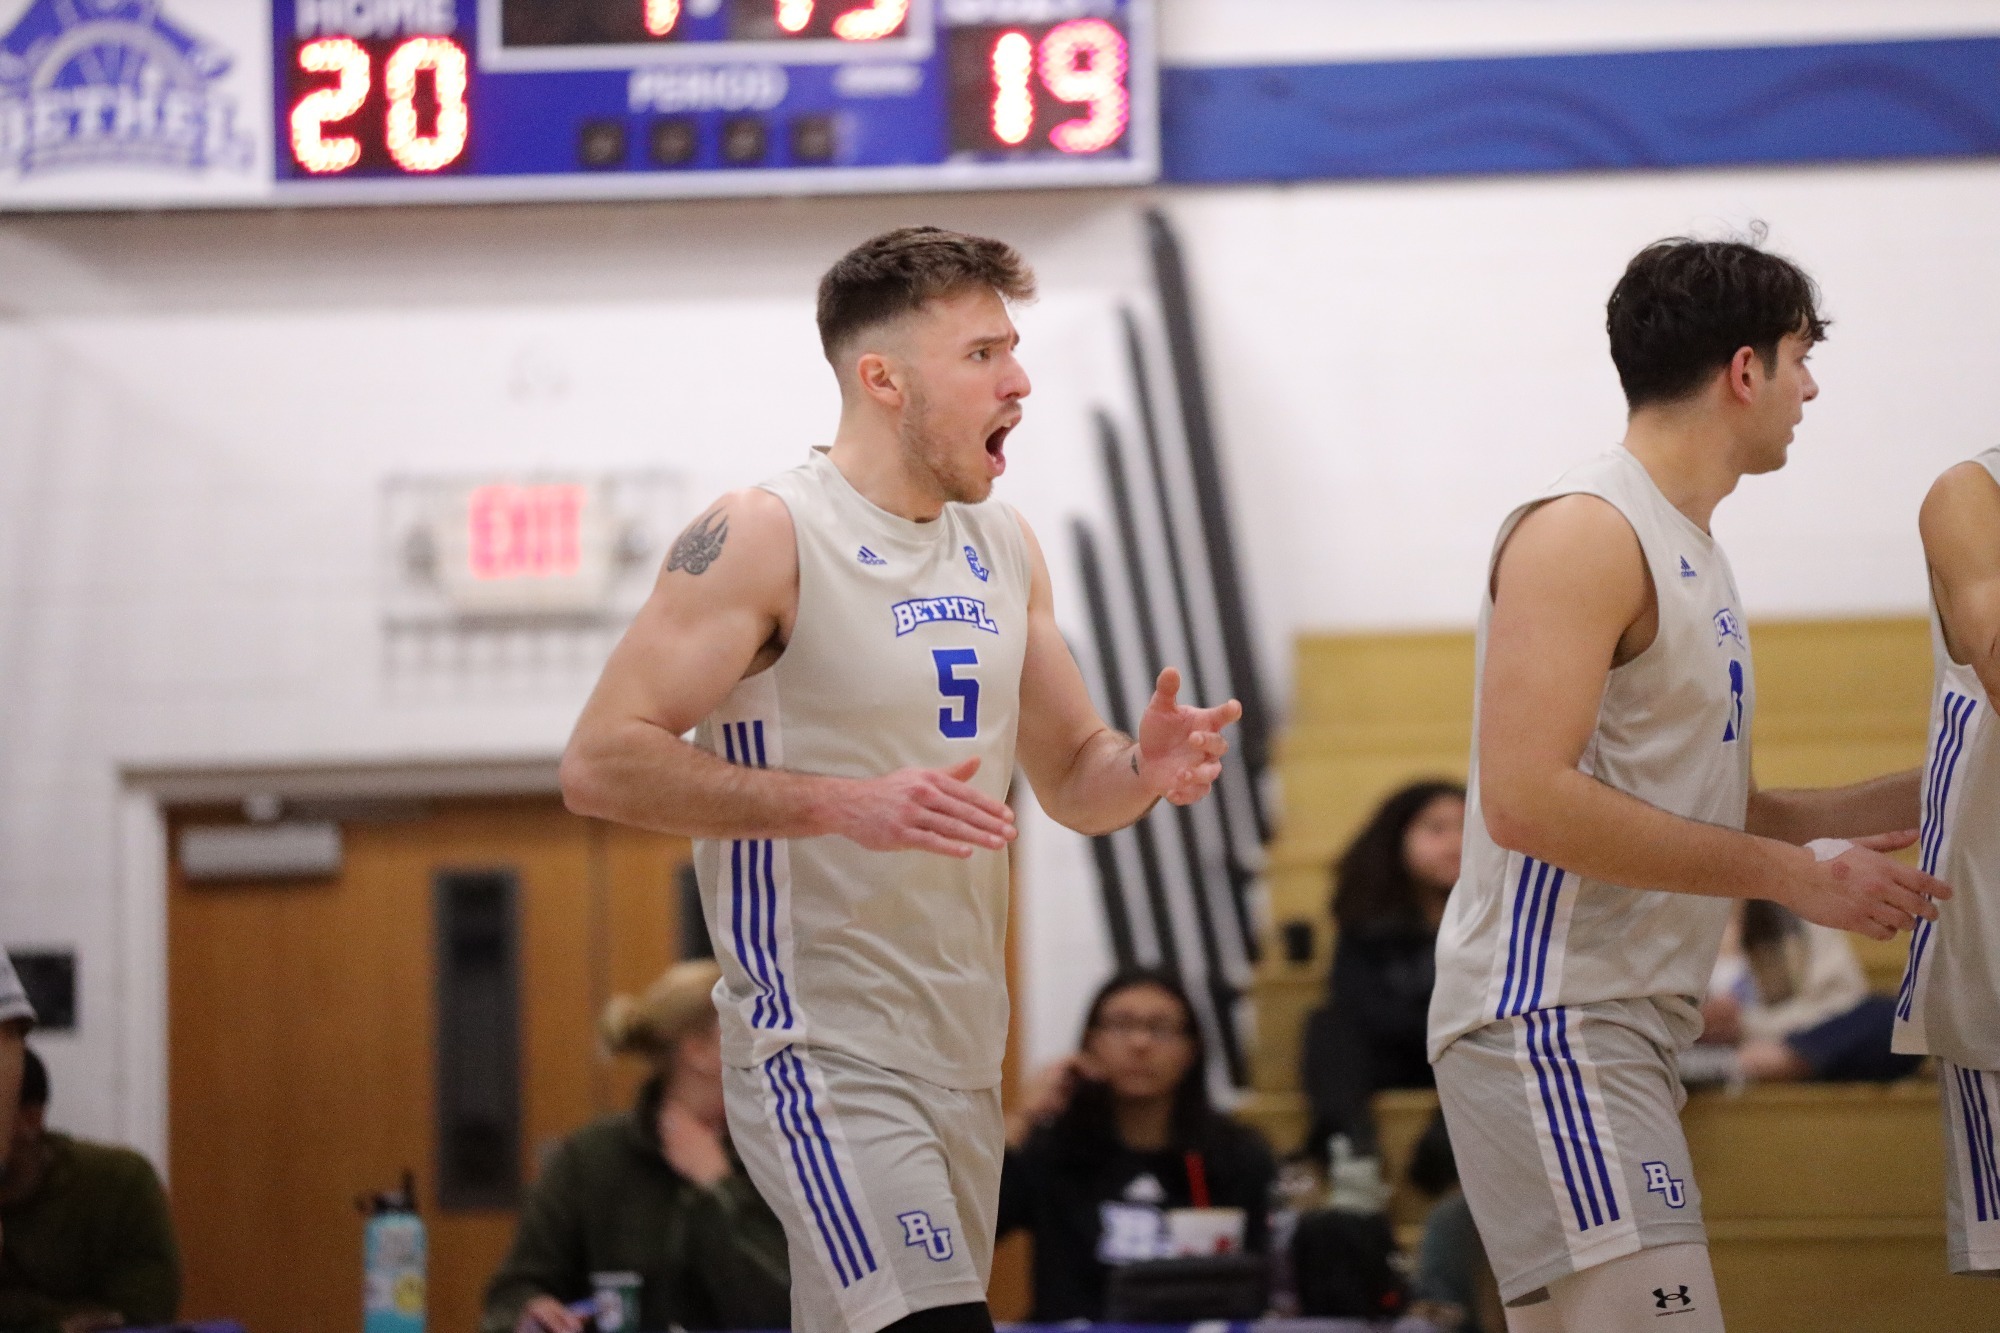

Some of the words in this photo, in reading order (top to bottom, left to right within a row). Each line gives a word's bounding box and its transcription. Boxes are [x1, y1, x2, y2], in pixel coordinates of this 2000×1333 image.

[291, 37, 470, 172] 20
[991, 18, 1130, 153] 19
[891, 596, 999, 637] BETHEL
[931, 648, 980, 739] 5
